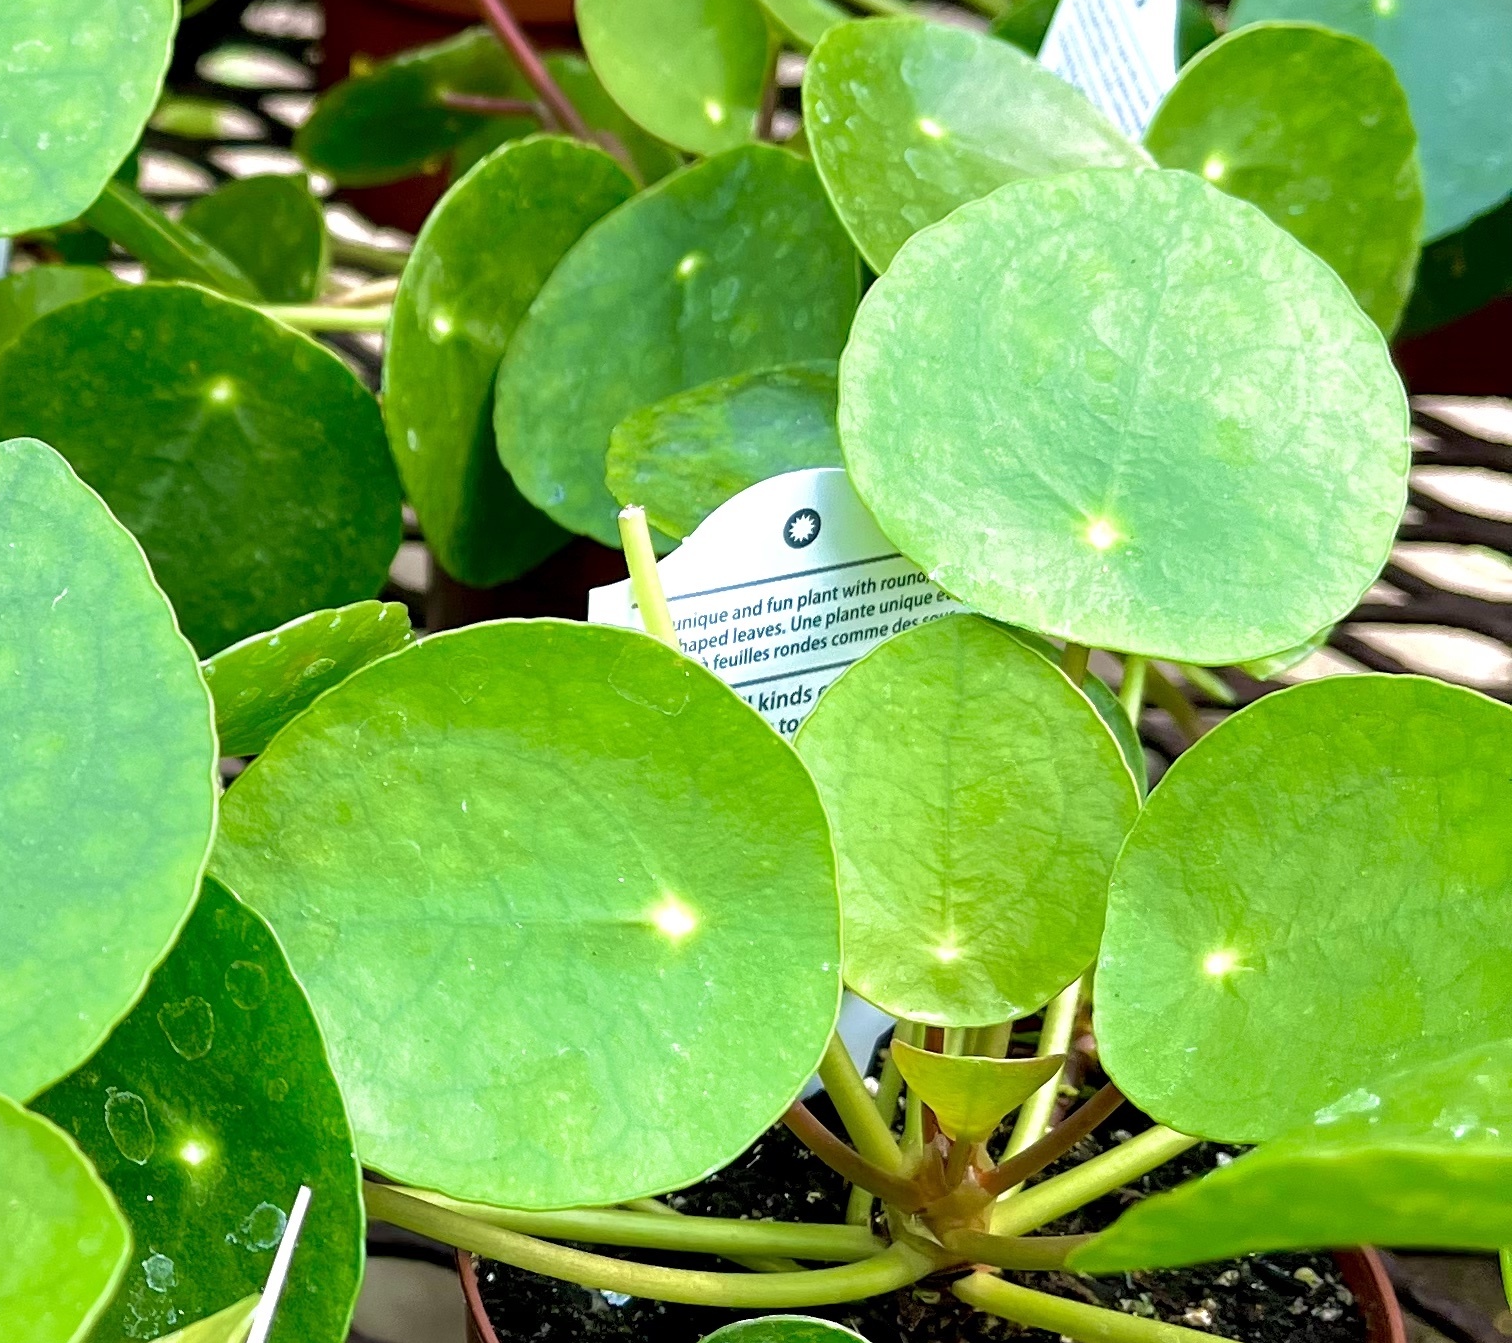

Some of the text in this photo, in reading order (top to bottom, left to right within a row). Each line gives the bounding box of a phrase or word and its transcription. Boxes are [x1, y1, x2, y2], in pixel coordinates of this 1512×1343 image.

[672, 610, 729, 632] unique
[732, 599, 763, 620] and
[766, 596, 793, 615] fun
[797, 588, 839, 612] plant
[842, 576, 877, 599] with
[678, 628, 729, 654] haped
[732, 621, 787, 644] leaves.
[791, 614, 823, 633] Une
[825, 603, 876, 629] plante
[879, 590, 933, 613] unique
[713, 646, 770, 671] feuilles
[773, 634, 828, 657] rondes
[831, 624, 889, 647] comme
[892, 616, 918, 634] des
[758, 684, 813, 712] kinds
